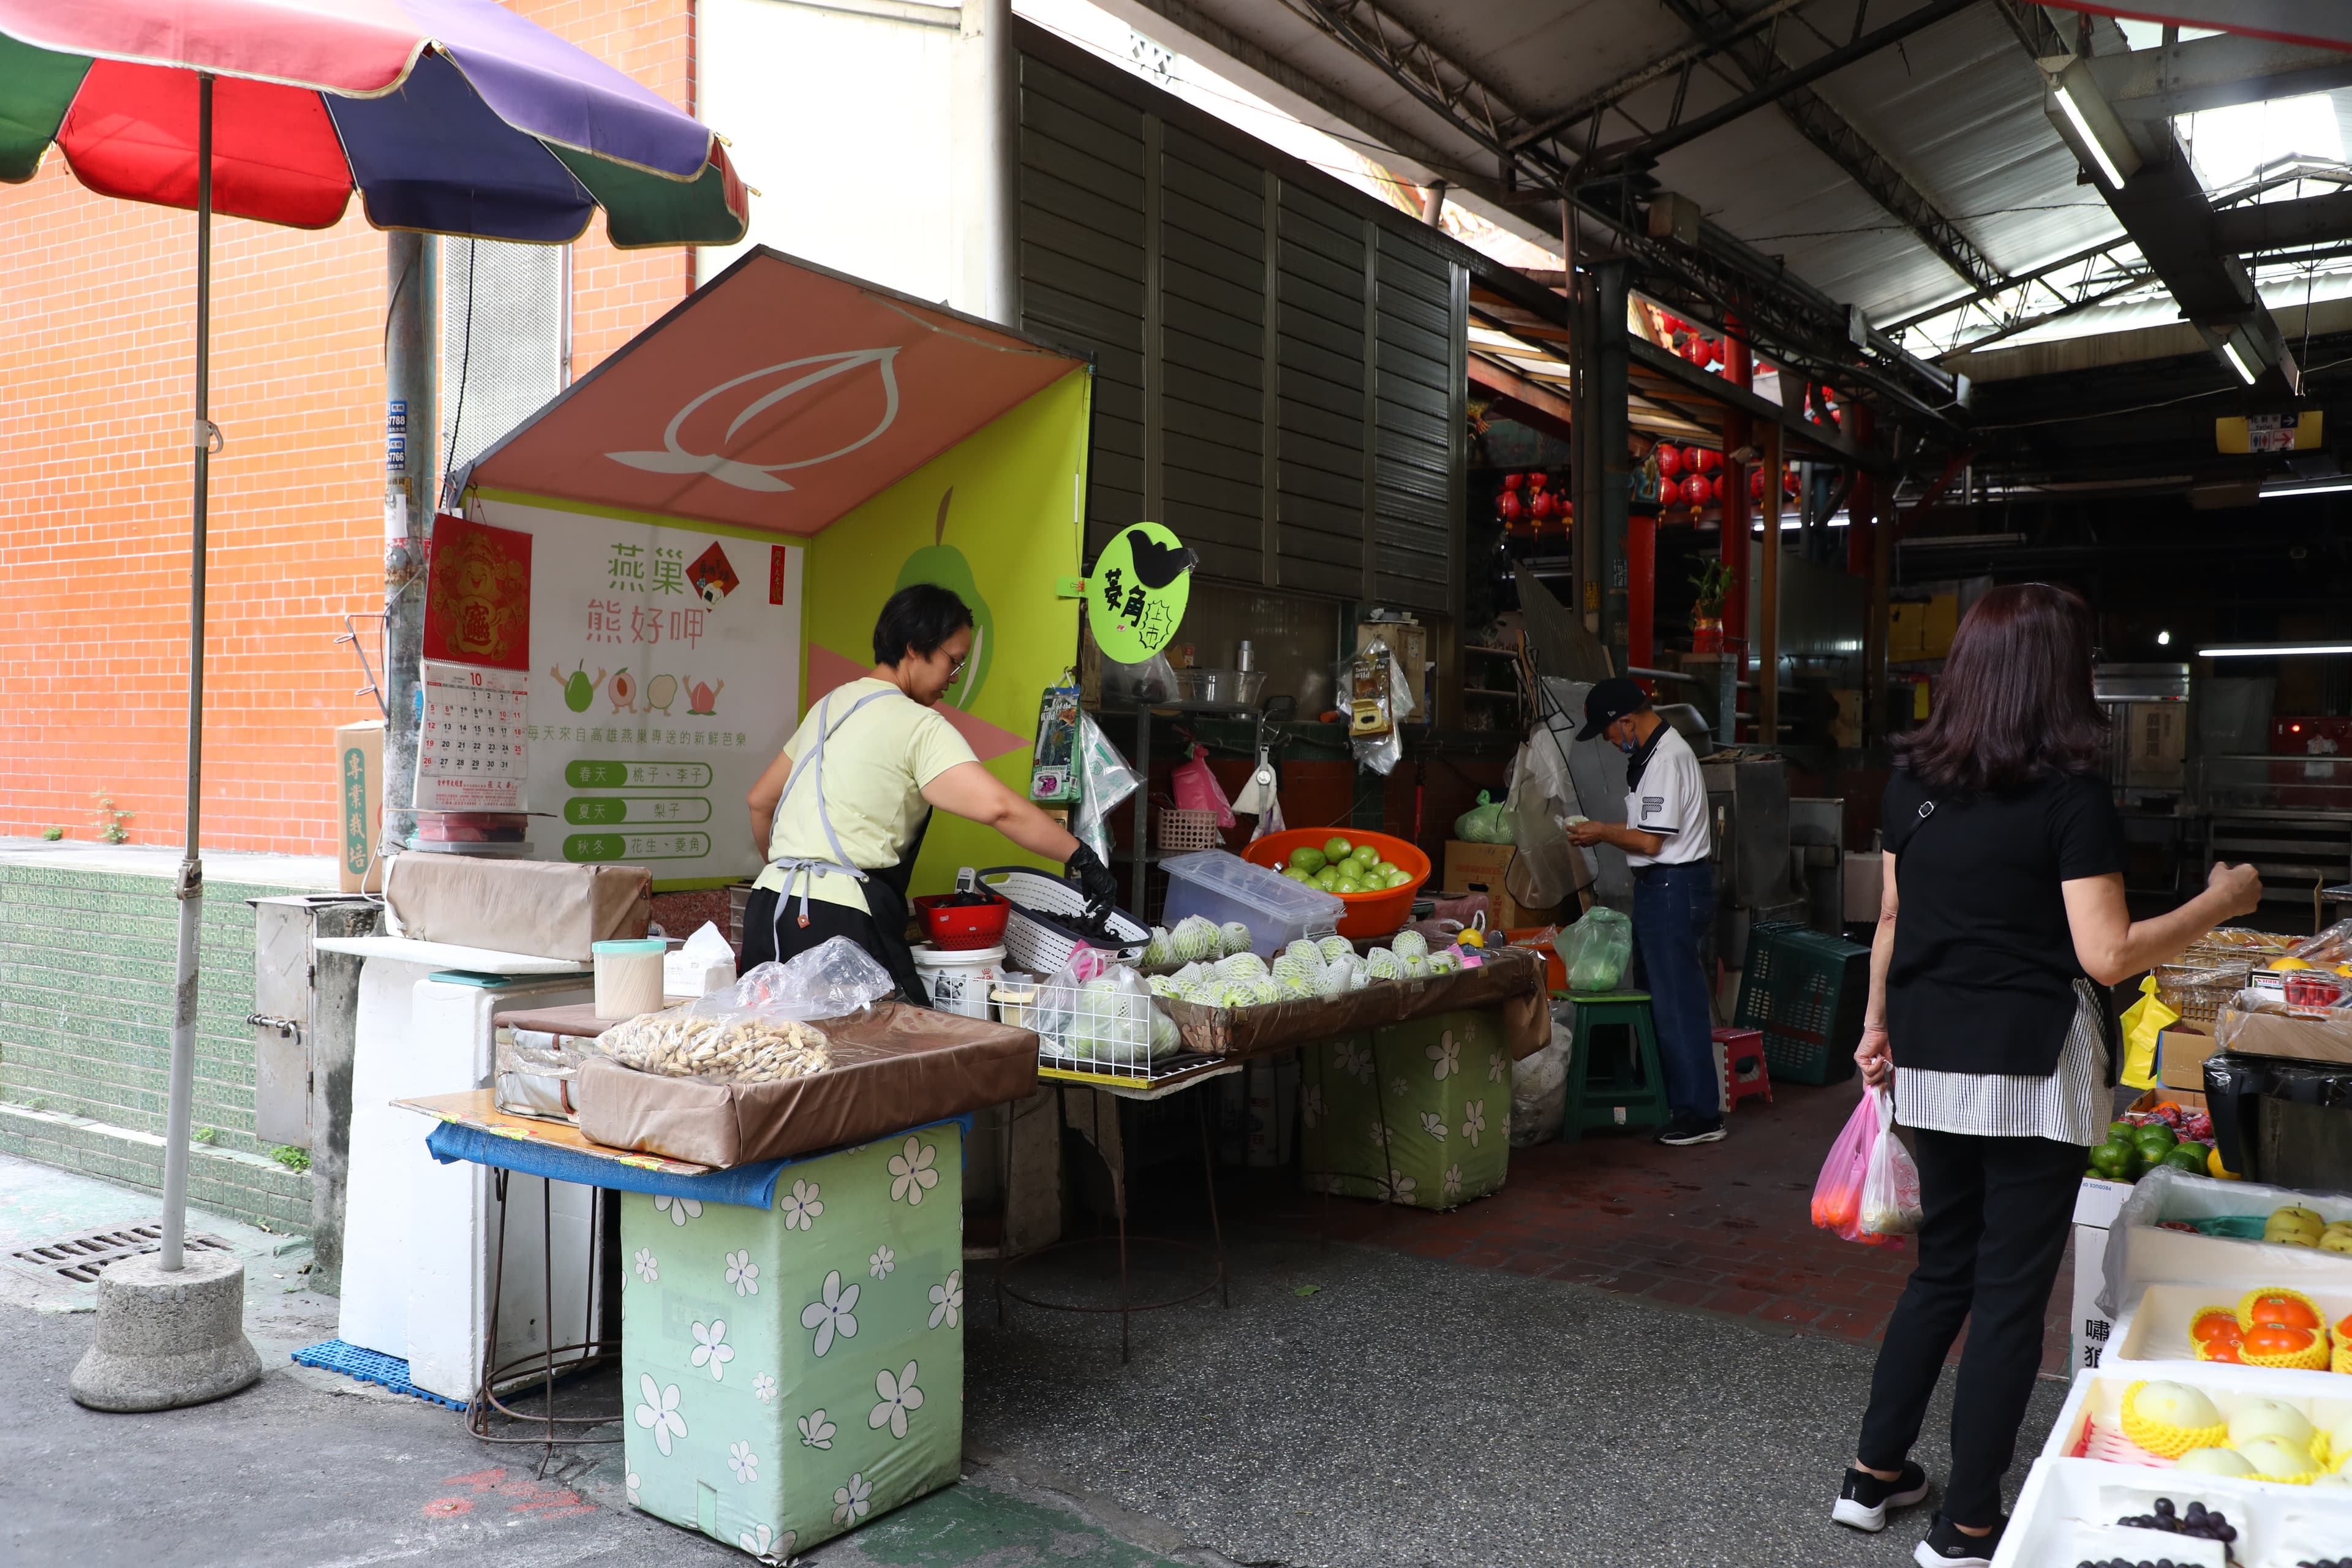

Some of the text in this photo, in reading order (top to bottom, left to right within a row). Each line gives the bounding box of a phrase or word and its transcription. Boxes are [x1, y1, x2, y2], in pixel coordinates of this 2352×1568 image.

[608, 543, 684, 595] 燕巢
[1104, 568, 1147, 628] 菱角
[586, 598, 704, 650] 熊好呷
[1146, 608, 1163, 644] 上市
[470, 673, 482, 686] 10
[1041, 711, 1055, 721] Wild
[528, 725, 747, 747] 每天來自高雄燕巢專送的新鮮芭樂
[579, 766, 607, 783] 春天
[347, 752, 366, 868] 專業栽培
[578, 804, 606, 820] 夏天
[654, 803, 680, 818] 梨子
[577, 839, 605, 855] 秋冬
